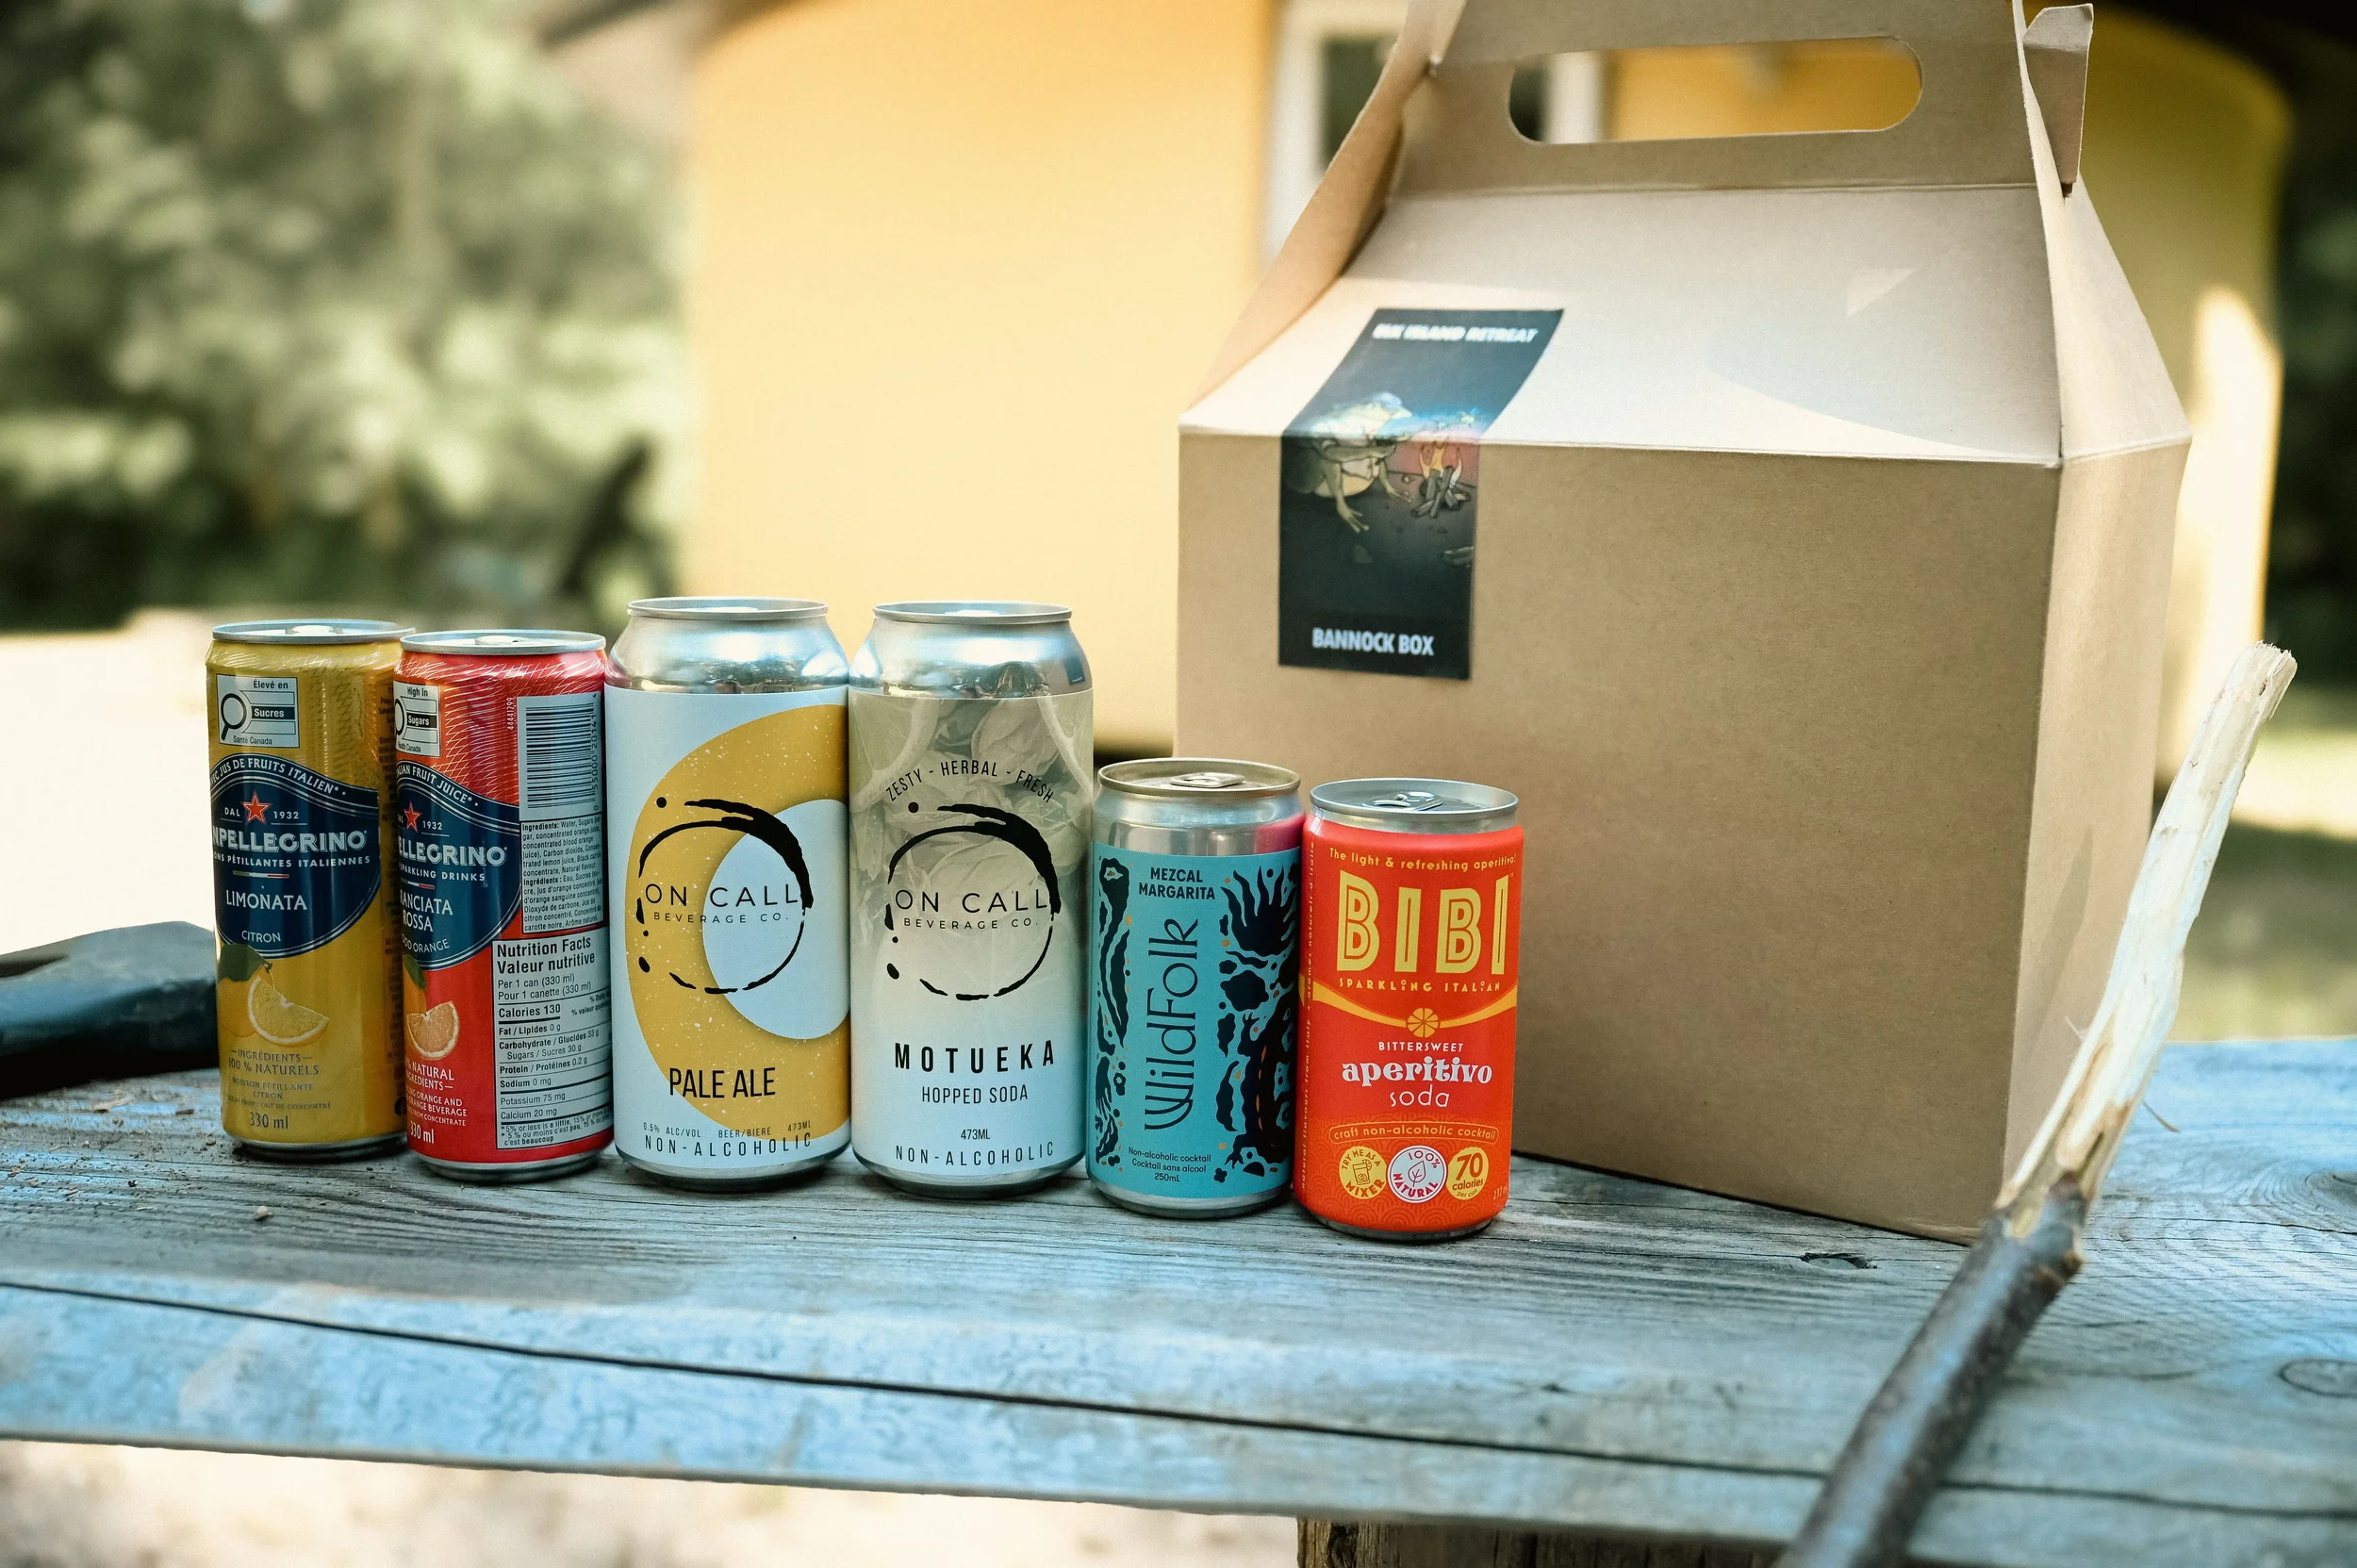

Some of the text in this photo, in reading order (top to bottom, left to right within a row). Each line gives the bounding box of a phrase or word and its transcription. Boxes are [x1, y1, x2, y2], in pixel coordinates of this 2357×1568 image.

[1312, 627, 1434, 655] BANNOCK BOX
[254, 680, 275, 688] Élevé
[407, 686, 428, 697] High in
[254, 709, 284, 718] Sucres
[408, 716, 429, 726] Sugars
[233, 735, 272, 745] Santé Canada
[221, 763, 231, 776] JUS
[233, 759, 245, 769] DE
[248, 758, 285, 773] FRUITS
[413, 767, 437, 784] FRUIT
[886, 760, 1054, 802] ZESTY HERBAL FRESH
[224, 807, 240, 817] DAL
[423, 821, 442, 830] 1932
[522, 822, 559, 832] Ingredients:
[536, 830, 572, 839] concentrated
[523, 840, 561, 849] concentrated
[227, 854, 370, 867] PÉTILLANTES ITALIENNES
[1329, 848, 1346, 860] The
[1352, 852, 1379, 866] light
[1386, 857, 1394, 867] &
[1401, 859, 1468, 872] refreshing
[442, 872, 486, 881] DRINKS
[1150, 867, 1203, 883] MEZCAL
[646, 883, 799, 907] ON CALL
[1139, 883, 1215, 900] MARGARITA
[226, 890, 307, 910] LIMONATA
[896, 889, 1047, 913] ON CALL
[404, 910, 433, 932] ROSSA
[654, 912, 788, 923] BEVERAGE CO.
[904, 918, 1038, 929] BEVERAGE CO.
[1337, 869, 1509, 975] BIBI
[241, 931, 281, 943] CITRON
[413, 939, 450, 953] ORANGE
[498, 936, 590, 957] Nutrition Facts
[498, 952, 594, 974] Valeur nutritive
[499, 980, 512, 988] Per
[542, 976, 560, 987] (330
[563, 973, 575, 982] ml)
[1340, 978, 1500, 992] SPARKLING ITALIAN
[530, 989, 559, 999] canette
[563, 984, 578, 996] (330
[581, 982, 591, 991] ml)
[499, 1007, 540, 1017] Calories
[544, 1004, 560, 1015] 130
[519, 1025, 547, 1034] Lipides
[1145, 918, 1198, 1131] WildFolk
[500, 1032, 585, 1049] Carbohydrate Glucides
[1378, 1042, 1464, 1052] BITTERSWEET
[507, 1051, 534, 1060] Sugars
[542, 1048, 566, 1056] Sucres
[895, 1040, 1054, 1073] MOTUEKA
[229, 1058, 319, 1075] 100 NATURELS
[413, 1062, 454, 1081] NATURAL
[500, 1057, 582, 1074] Protein Protéines 0.2
[1342, 1056, 1492, 1087] aperitivo
[669, 1067, 776, 1098] PALE ALE
[253, 1091, 283, 1099] CITRON
[417, 1092, 441, 1104] ORANGE
[501, 1096, 540, 1105] Potassium
[922, 1084, 1028, 1104] HOPPED SODA
[1391, 1084, 1449, 1107] soda
[428, 1104, 467, 1116] BEVERAGE
[250, 1112, 288, 1129] 330 ml
[424, 1114, 466, 1126] CONCENTRATE
[411, 1121, 434, 1144] 330 ml
[644, 1120, 811, 1137] 0.5% ALC/VOL 473ML
[961, 1129, 990, 1140] 473ML
[1334, 1125, 1496, 1140] craft non-alcoholic cocktail
[522, 1136, 553, 1145] beaucoup
[645, 1132, 811, 1157] NON-ALCOHOLIC
[896, 1142, 1053, 1165] NON-ALCOHOLIC
[1129, 1147, 1178, 1161] Non-alcoholic
[1342, 1148, 1375, 1169] TRY ME AS
[1409, 1150, 1441, 1168] 100%
[1132, 1158, 1161, 1169] Cocktail
[1457, 1152, 1483, 1180] 70
[1155, 1173, 1180, 1181] 250mL
[1393, 1173, 1439, 1197] NATURAL
[1452, 1179, 1483, 1191] calories
[1345, 1179, 1385, 1197] MIXER
